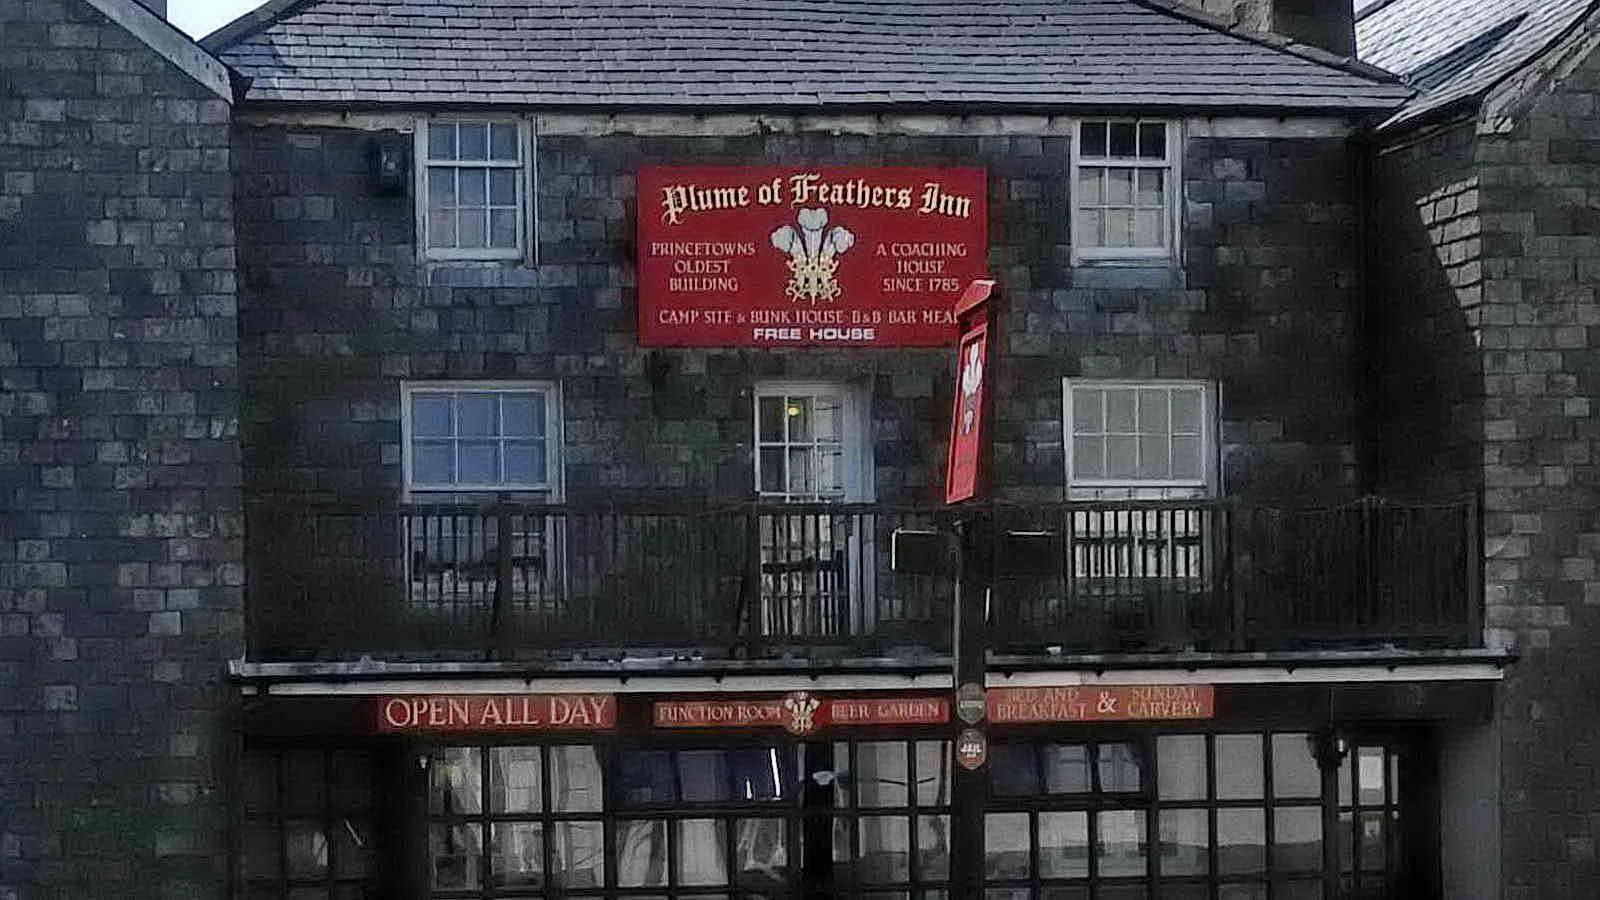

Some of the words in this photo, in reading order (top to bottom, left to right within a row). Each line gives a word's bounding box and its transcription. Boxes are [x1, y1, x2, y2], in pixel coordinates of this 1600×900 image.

[661, 184, 750, 225] Plume
[758, 177, 782, 206] of
[788, 172, 913, 209] Feathers
[918, 182, 971, 218] Inn
[651, 242, 756, 256] PRINCETOWNS
[876, 243, 887, 256] A
[891, 243, 967, 256] COACHING
[674, 260, 730, 274] OLDEST
[897, 260, 945, 274] HOUSE
[669, 277, 738, 292] BUILDING
[883, 278, 920, 292] SINCE
[929, 278, 960, 292] 1785
[659, 309, 699, 324] CAMP
[704, 309, 732, 324] SITE
[736, 313, 746, 323] &
[750, 310, 790, 324] BUNK
[796, 310, 844, 324] HOUSE
[852, 310, 881, 324] B&B
[888, 310, 916, 324] BAR
[753, 328, 802, 340] FREE
[809, 328, 875, 340] HOUSE
[1096, 691, 1117, 713] &
[1127, 701, 1201, 718] CARVERY
[385, 698, 470, 727] OPEN
[479, 698, 539, 725] ALL
[550, 697, 608, 725] DAY
[659, 705, 734, 721] FUNCTION
[736, 705, 782, 722] ROOM
[831, 703, 869, 720] BEER
[877, 702, 939, 720] GARDEN
[996, 702, 1087, 720] BREAKFAST
